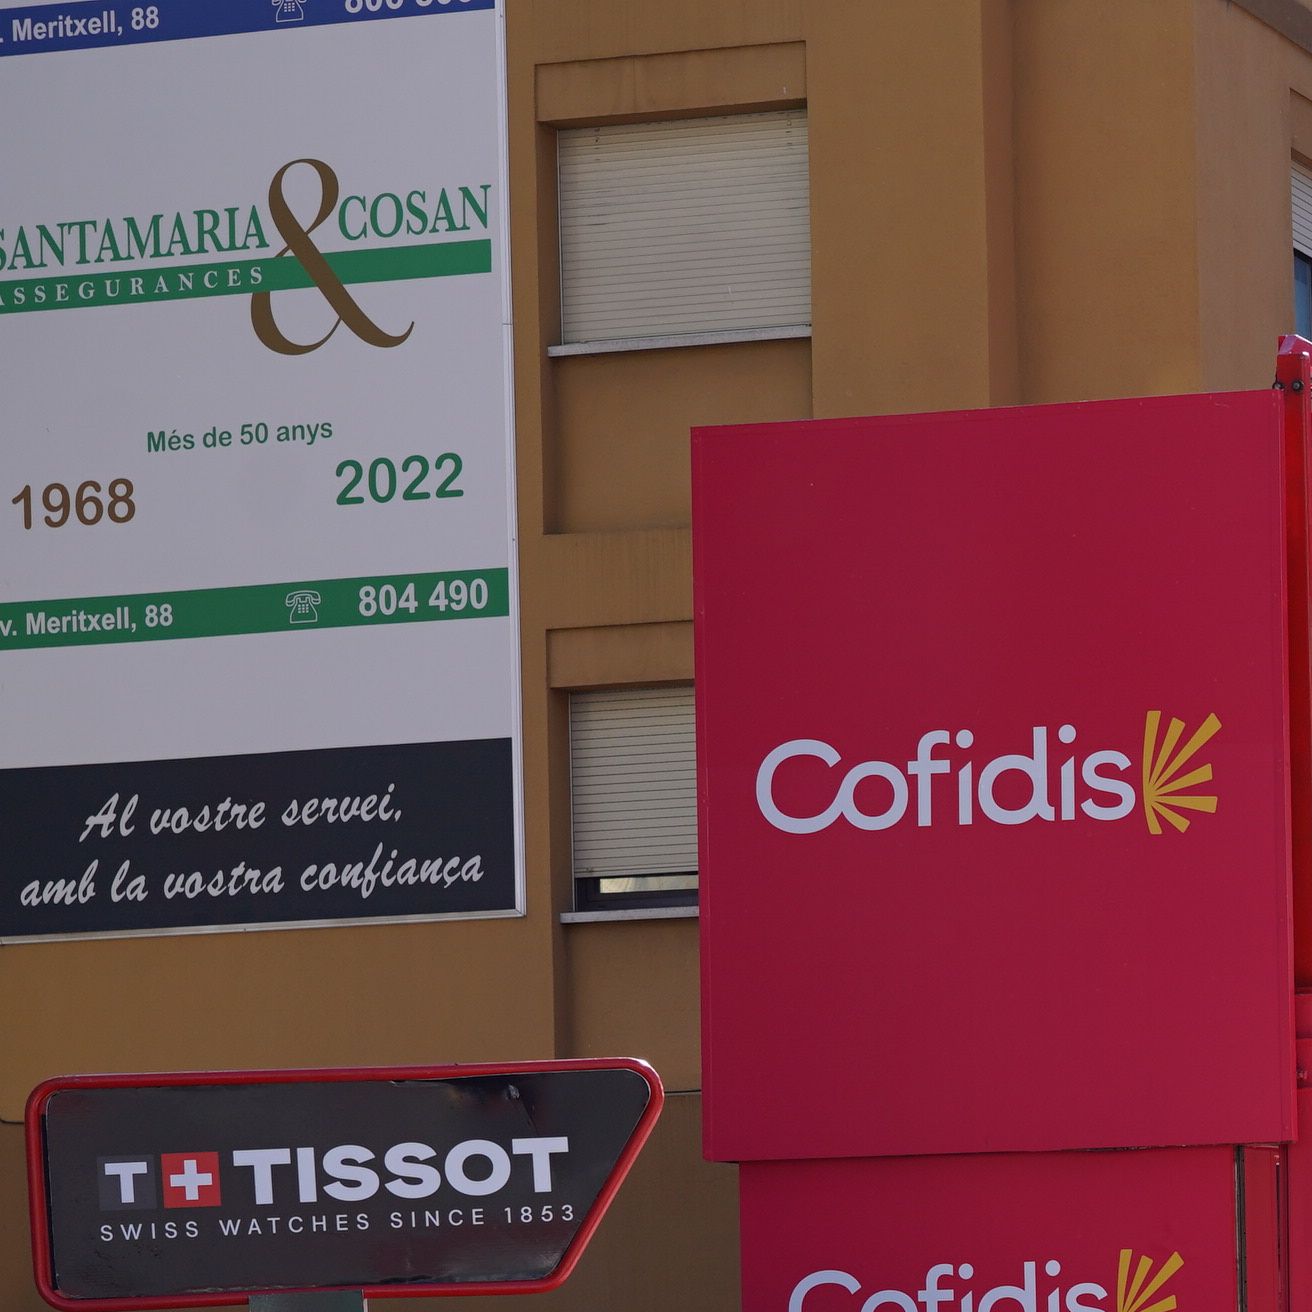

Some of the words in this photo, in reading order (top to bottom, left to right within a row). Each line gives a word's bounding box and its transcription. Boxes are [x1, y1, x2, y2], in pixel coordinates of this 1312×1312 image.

[12, 11, 123, 42] Meritxell,
[131, 6, 160, 31] 88
[338, 184, 492, 240] COSAN
[147, 428, 196, 453] Més
[202, 426, 232, 448] de
[240, 423, 269, 446] 50
[276, 419, 333, 446] anys
[12, 478, 136, 531] 1968
[335, 453, 464, 505] 2022
[26, 605, 137, 637] Meritxell,
[145, 603, 173, 628] 88
[358, 583, 418, 617] 804
[428, 577, 488, 611] 490
[756, 725, 1135, 834] Cofidis
[79, 793, 135, 843] Al
[150, 799, 267, 835] vostre
[282, 783, 403, 827] servei,
[20, 861, 97, 907] amb
[110, 858, 149, 903] la
[163, 870, 284, 898] vostra
[300, 842, 484, 893] confiança
[233, 1137, 570, 1204] TISSOT
[100, 1222, 200, 1241] SWISS
[219, 1213, 370, 1236] WATCHES
[390, 1207, 486, 1228] SINCE
[504, 1204, 576, 1224] 1853
